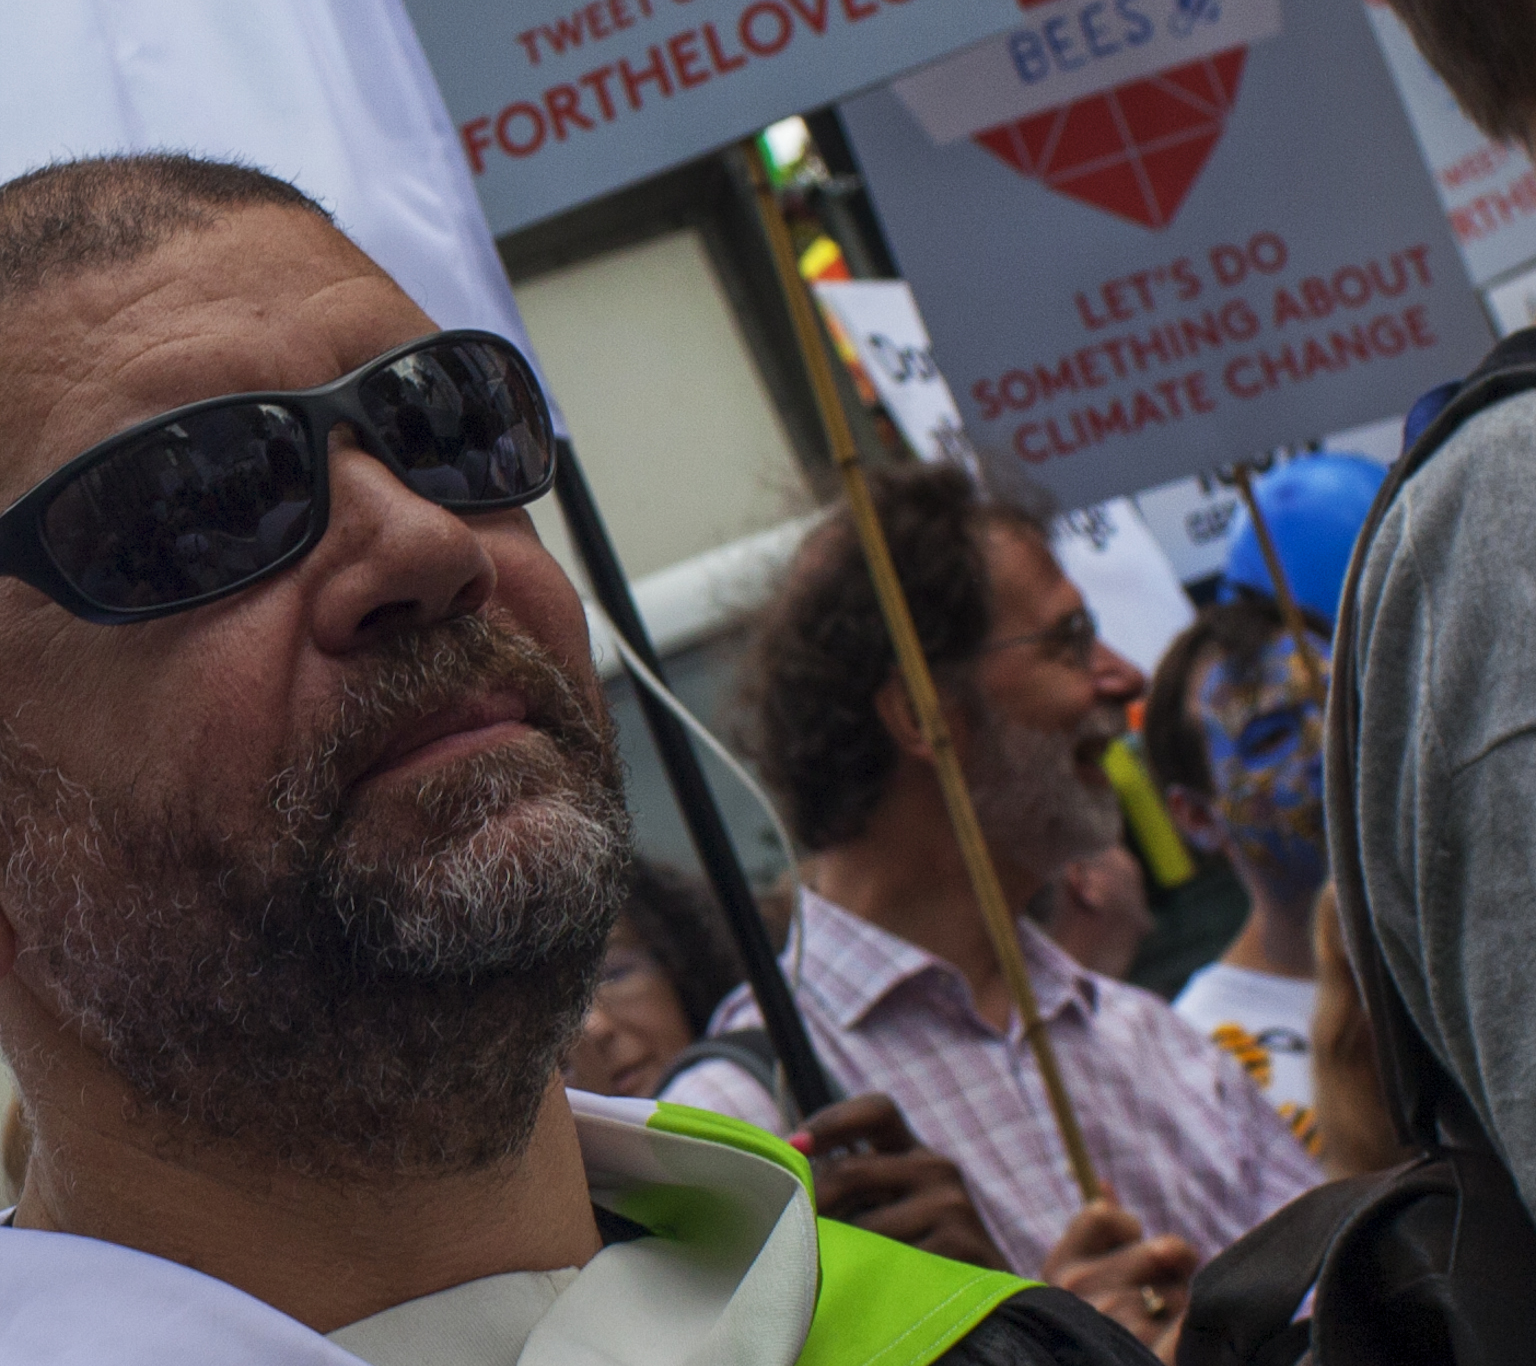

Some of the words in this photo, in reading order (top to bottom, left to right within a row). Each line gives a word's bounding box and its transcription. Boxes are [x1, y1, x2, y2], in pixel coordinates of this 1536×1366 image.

[970, 297, 1261, 423] SOMETHING
[1269, 242, 1437, 330] ABOUT
[1074, 240, 1202, 334] LET'S
[1208, 230, 1291, 291] DO
[1011, 359, 1218, 465] CLIMATE
[1222, 303, 1439, 403] CHANGE
